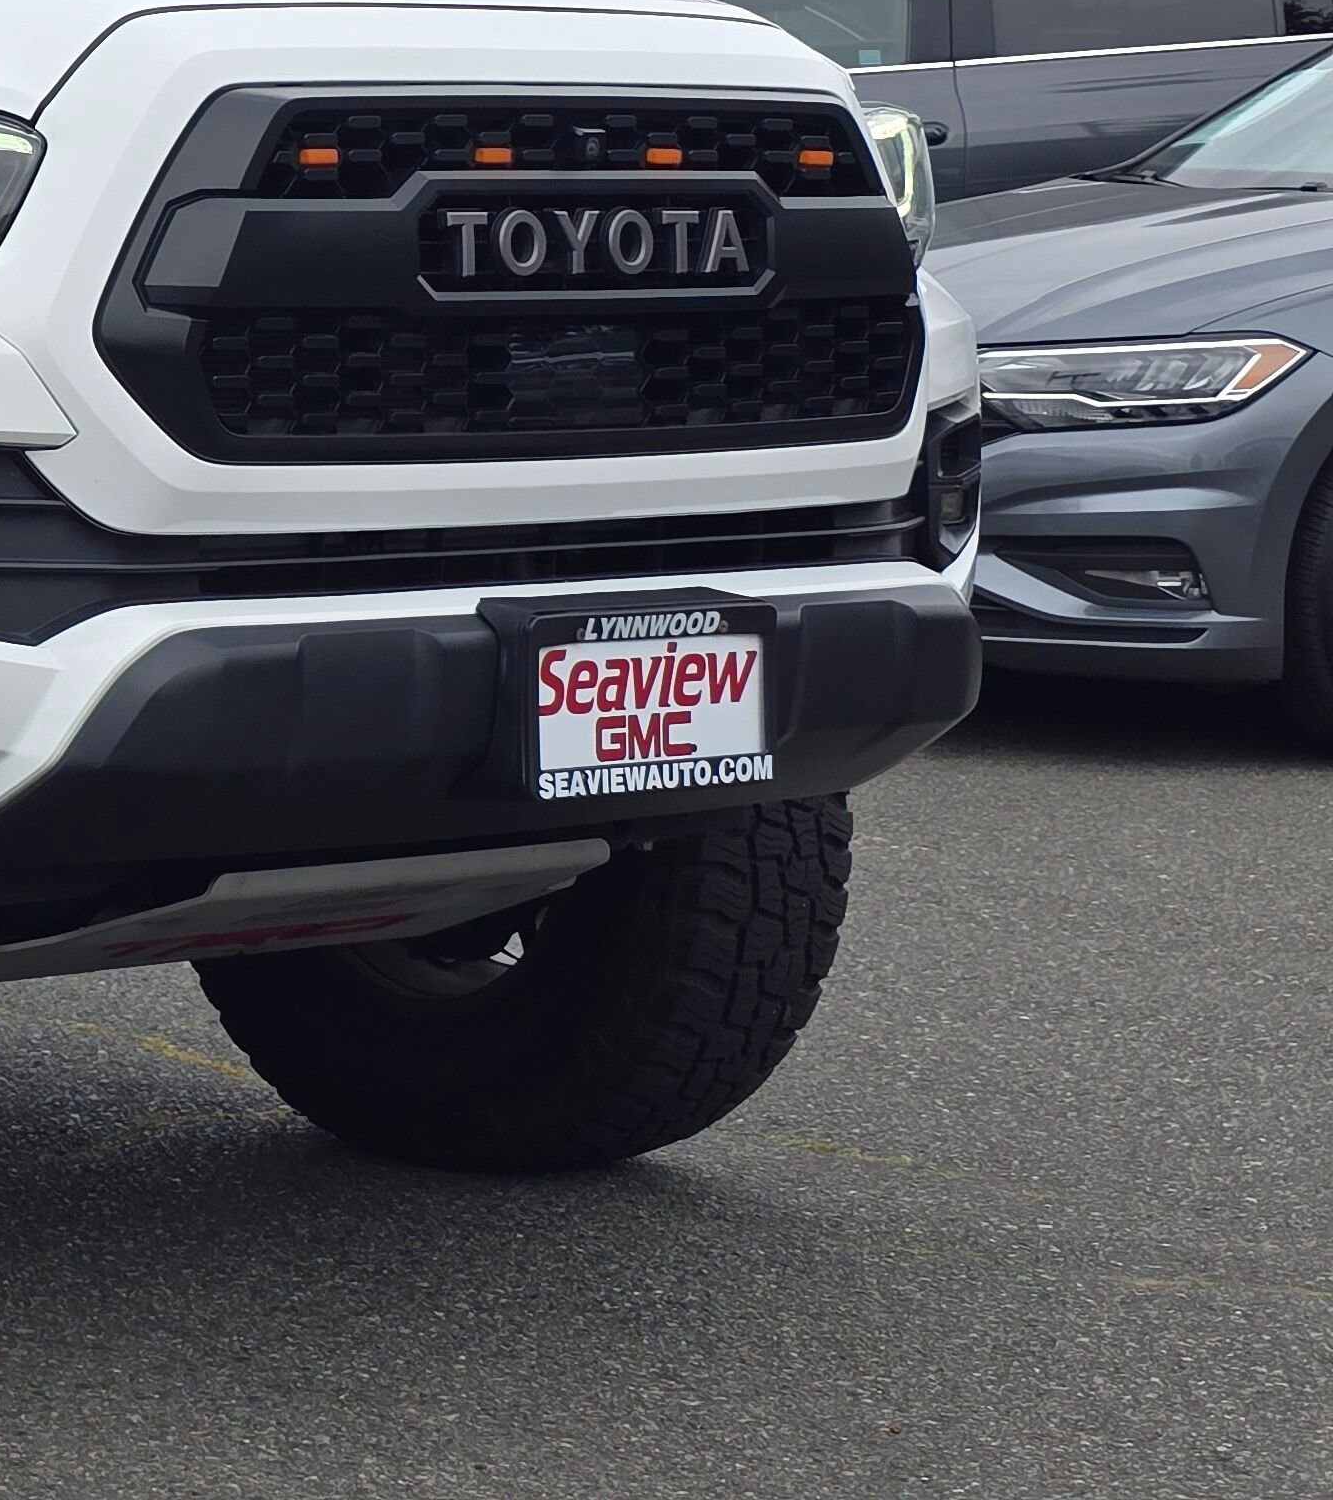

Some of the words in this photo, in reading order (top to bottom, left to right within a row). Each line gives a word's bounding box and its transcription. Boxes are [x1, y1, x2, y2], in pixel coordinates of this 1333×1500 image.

[441, 208, 751, 277] TOYOTA
[584, 611, 721, 641] LYNNWOOD
[539, 642, 758, 717] Seaview
[595, 711, 698, 762] GMC
[538, 754, 773, 800] SEAVIEWAUTO.COM
